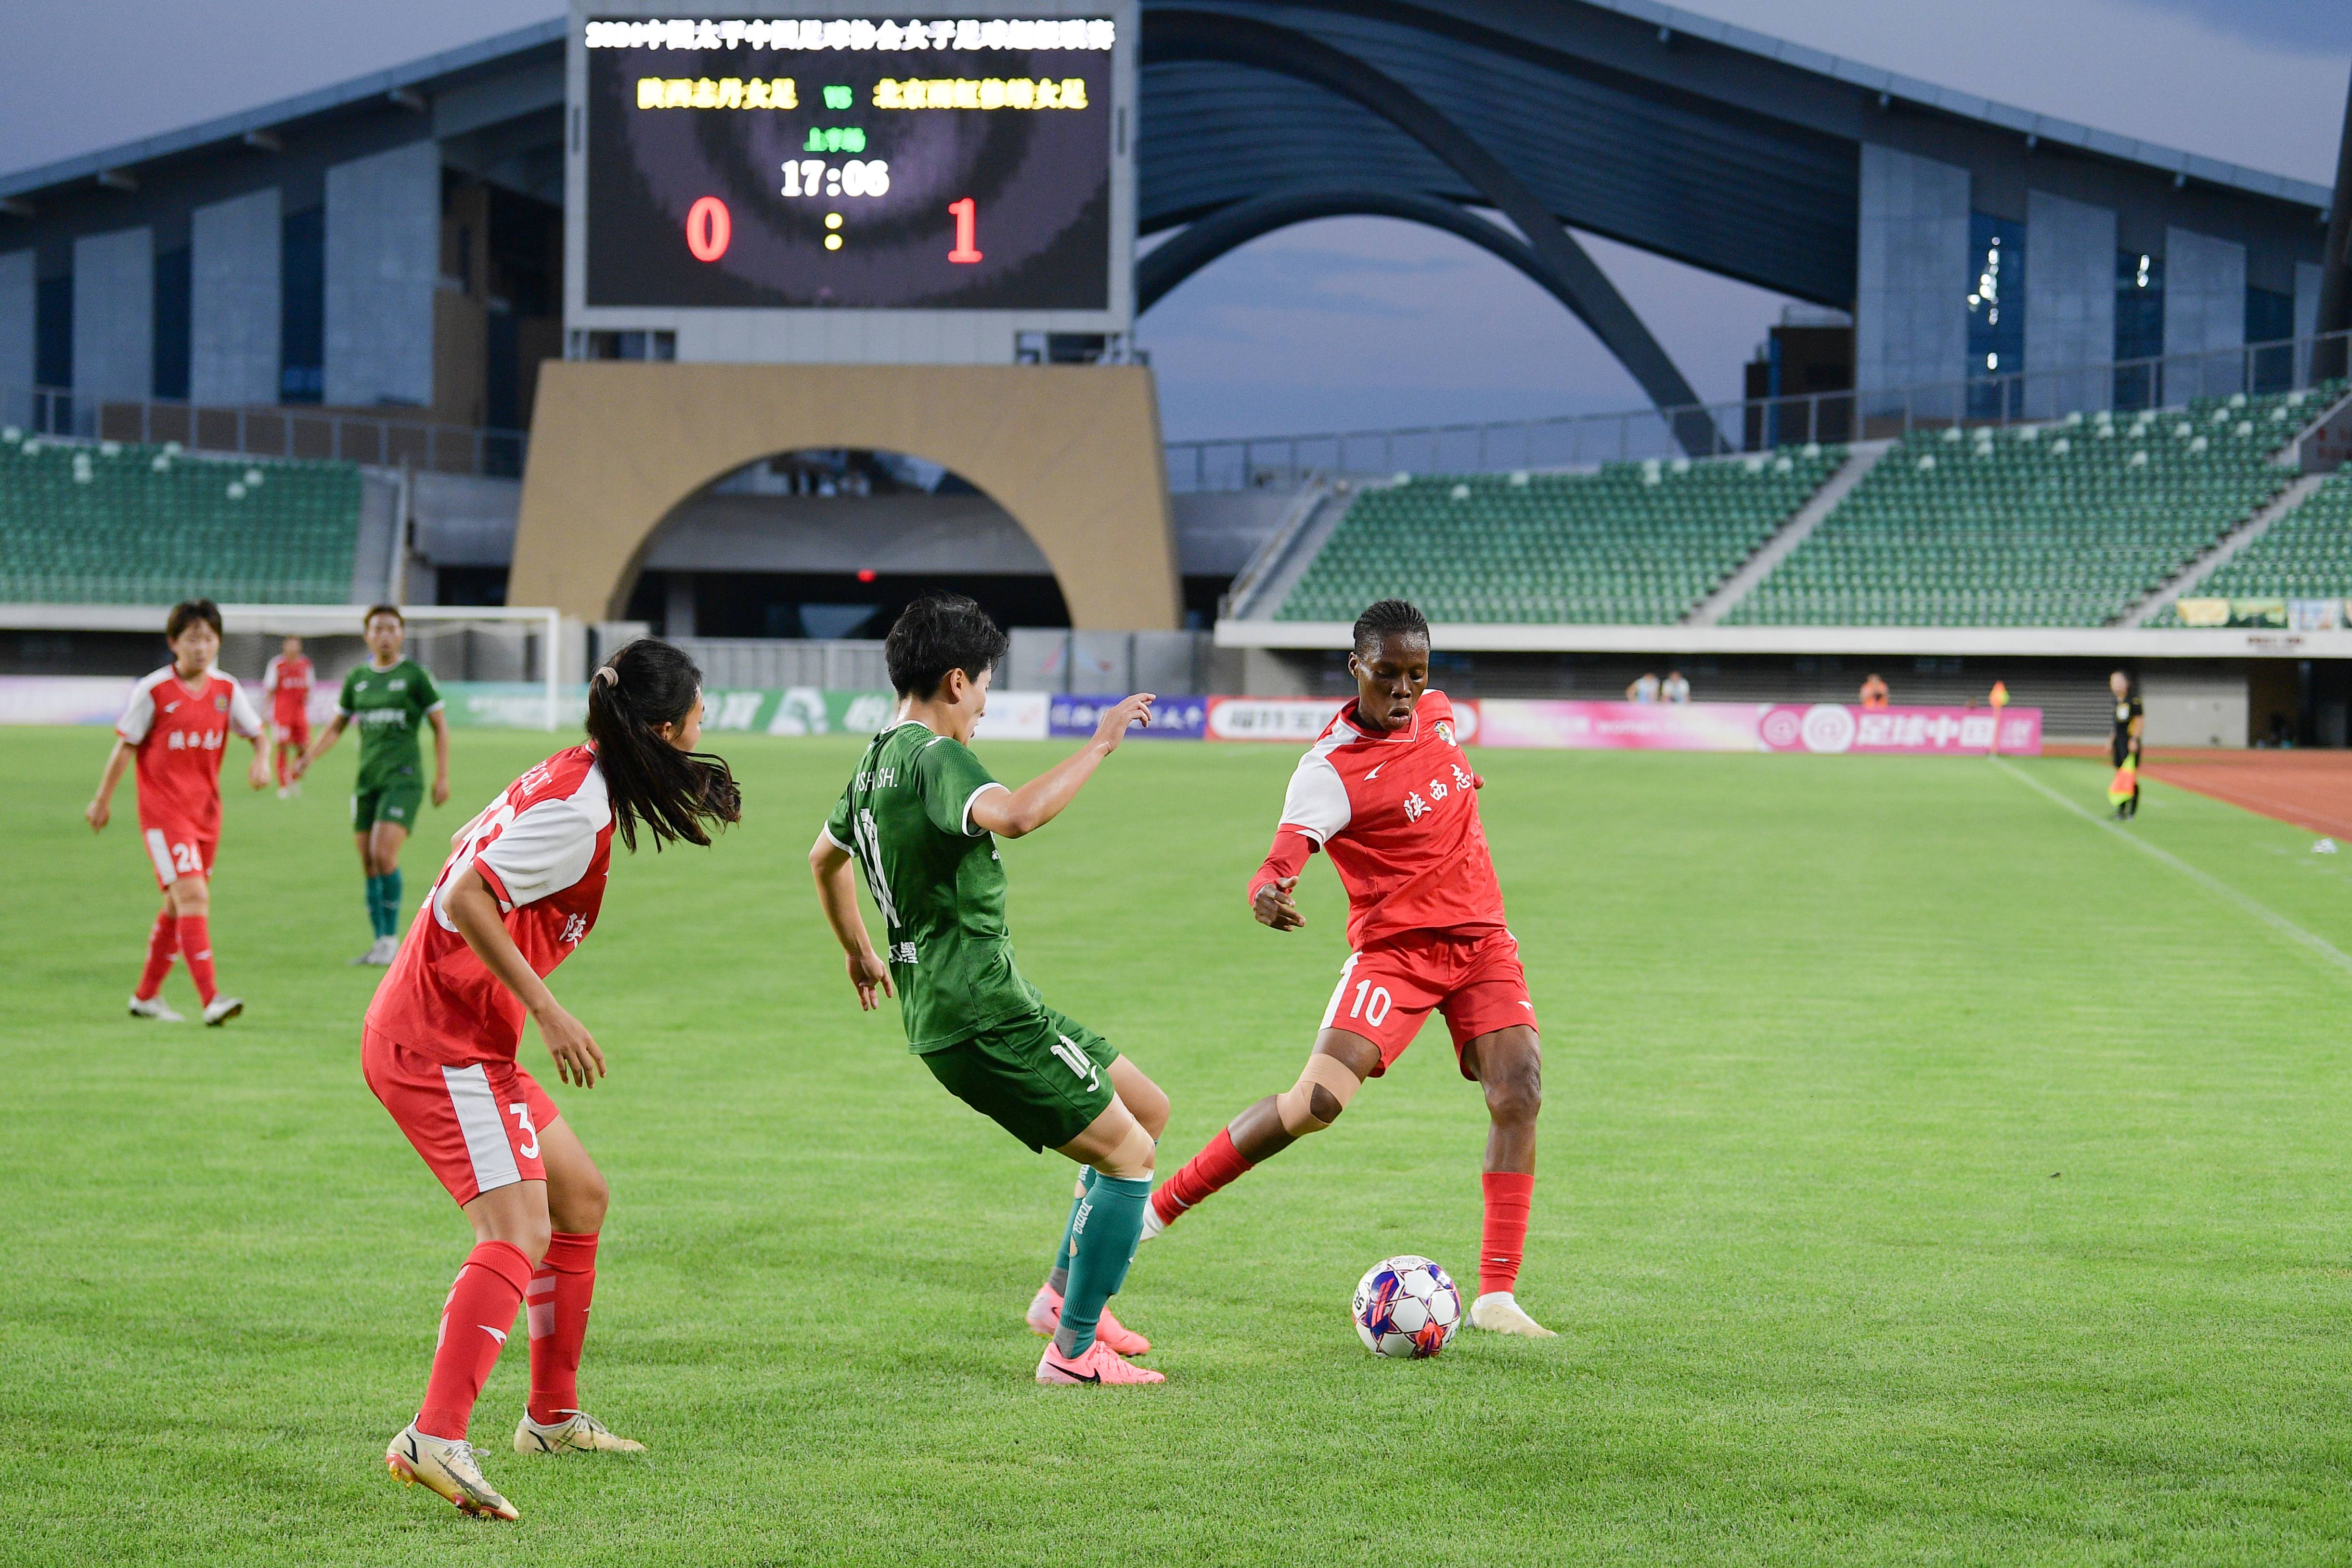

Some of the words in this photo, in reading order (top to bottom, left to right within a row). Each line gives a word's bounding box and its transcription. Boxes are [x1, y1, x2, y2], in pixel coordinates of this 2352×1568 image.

[781, 160, 890, 196] 17:06
[686, 195, 731, 261] 0
[947, 197, 982, 263] 1
[1403, 764, 1473, 823] 陕西志
[1350, 979, 1392, 1027] 10
[509, 1102, 540, 1159] 3
